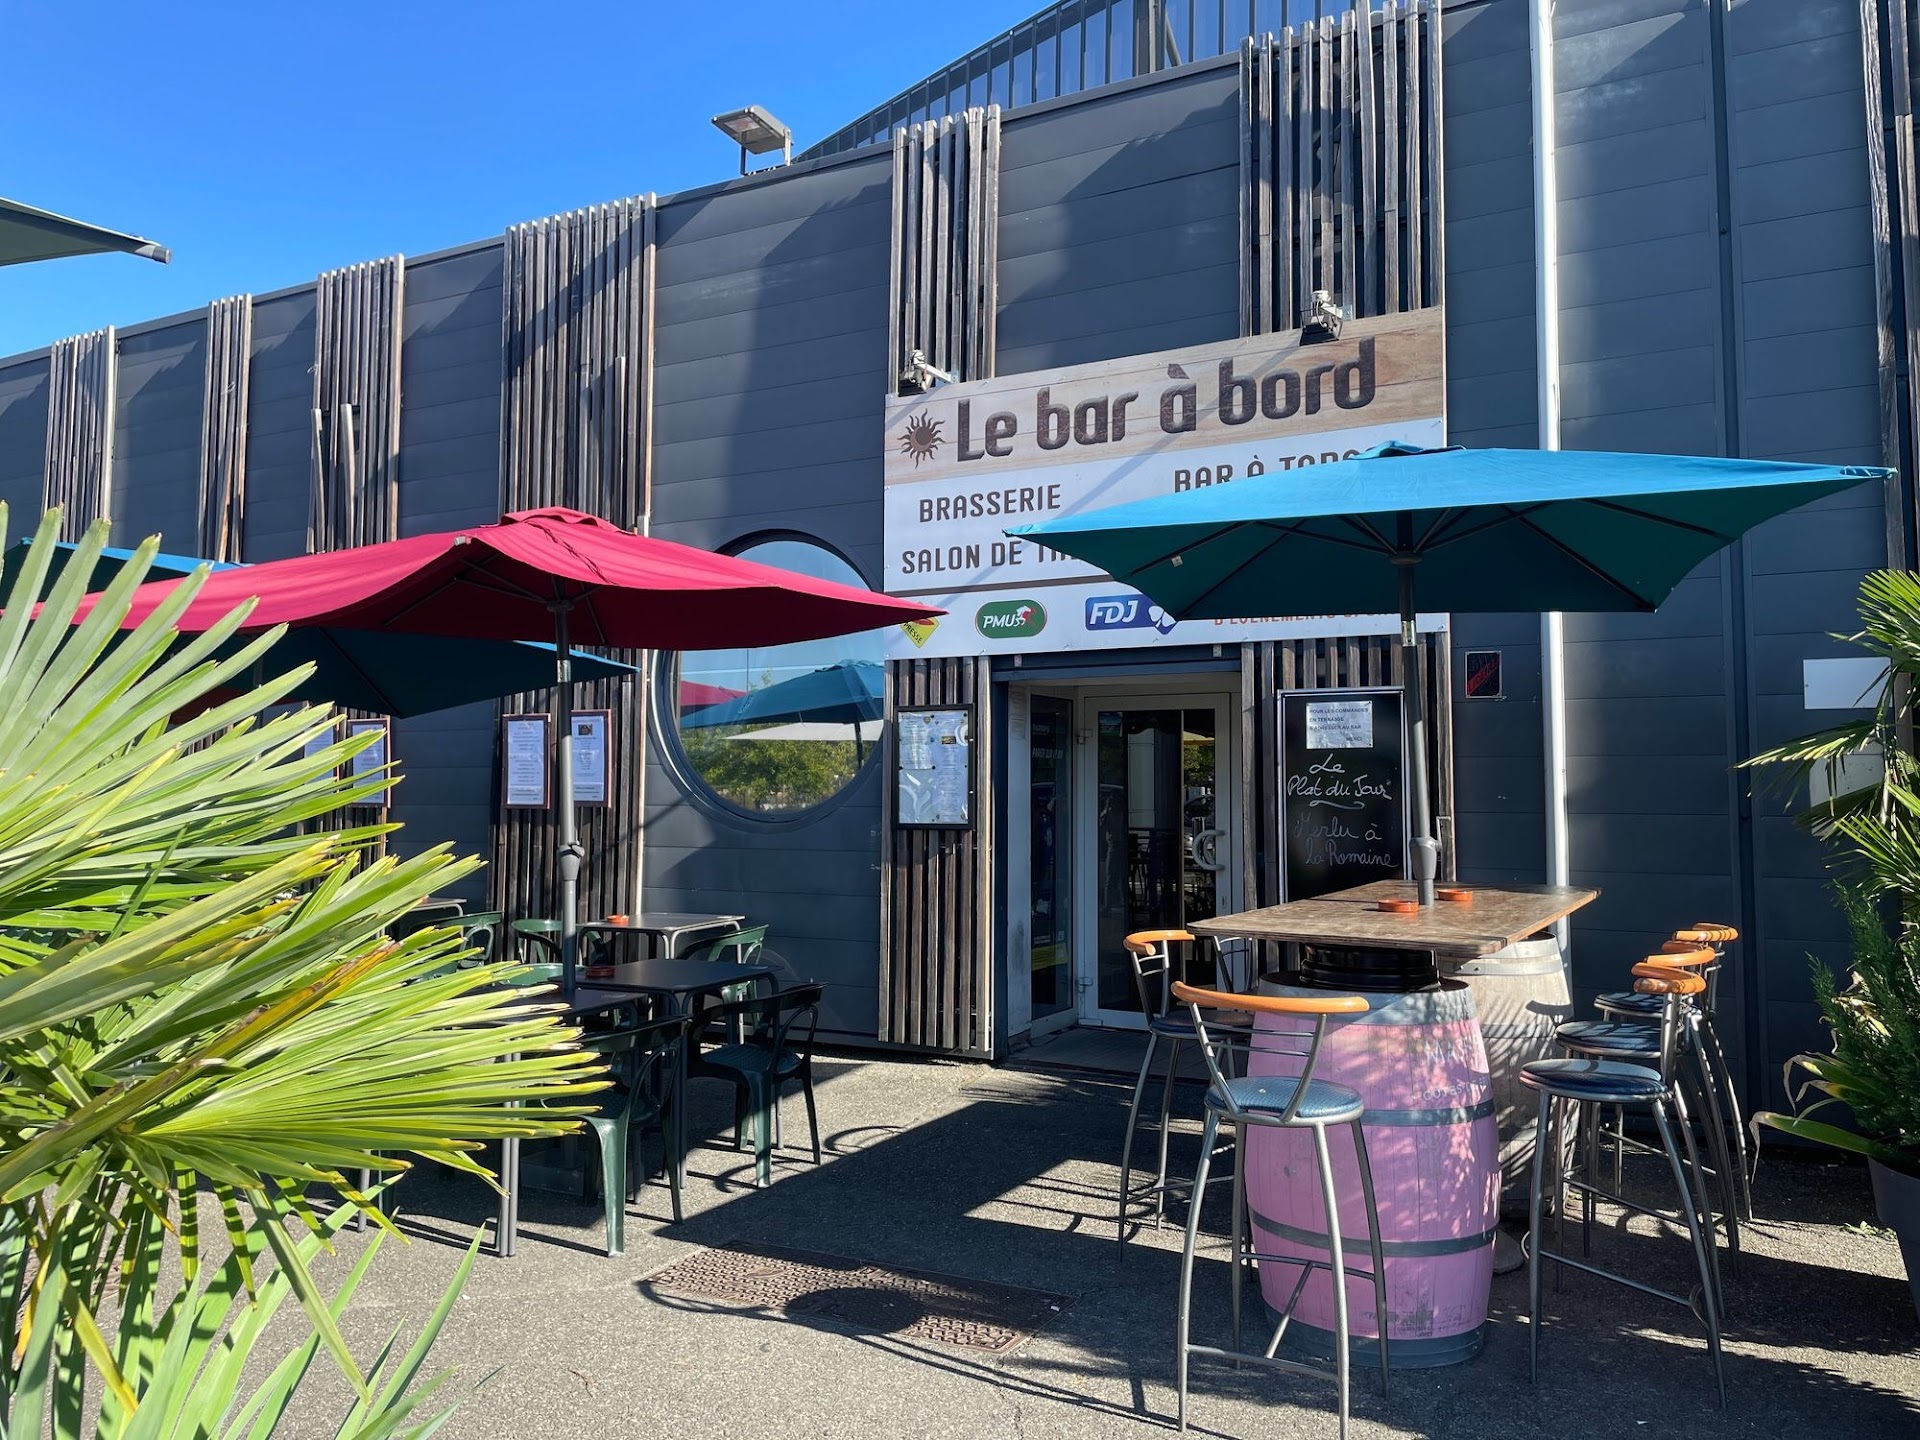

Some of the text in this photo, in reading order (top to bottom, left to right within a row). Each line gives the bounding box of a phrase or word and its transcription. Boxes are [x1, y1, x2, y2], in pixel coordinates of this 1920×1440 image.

[957, 335, 1377, 462] Le bar à bord
[1174, 463, 1234, 493] BAR
[919, 483, 1062, 523] BRASSERIE
[901, 543, 980, 574] SALON
[990, 540, 1023, 567] DE
[982, 614, 1015, 629] PMU
[1089, 600, 1139, 626] FDJ
[902, 622, 923, 644] PRESSE
[1308, 753, 1346, 775] Le
[1287, 775, 1323, 797] Plat
[1324, 778, 1351, 797] du
[1364, 822, 1383, 841] à
[1325, 840, 1400, 868] Romaine
